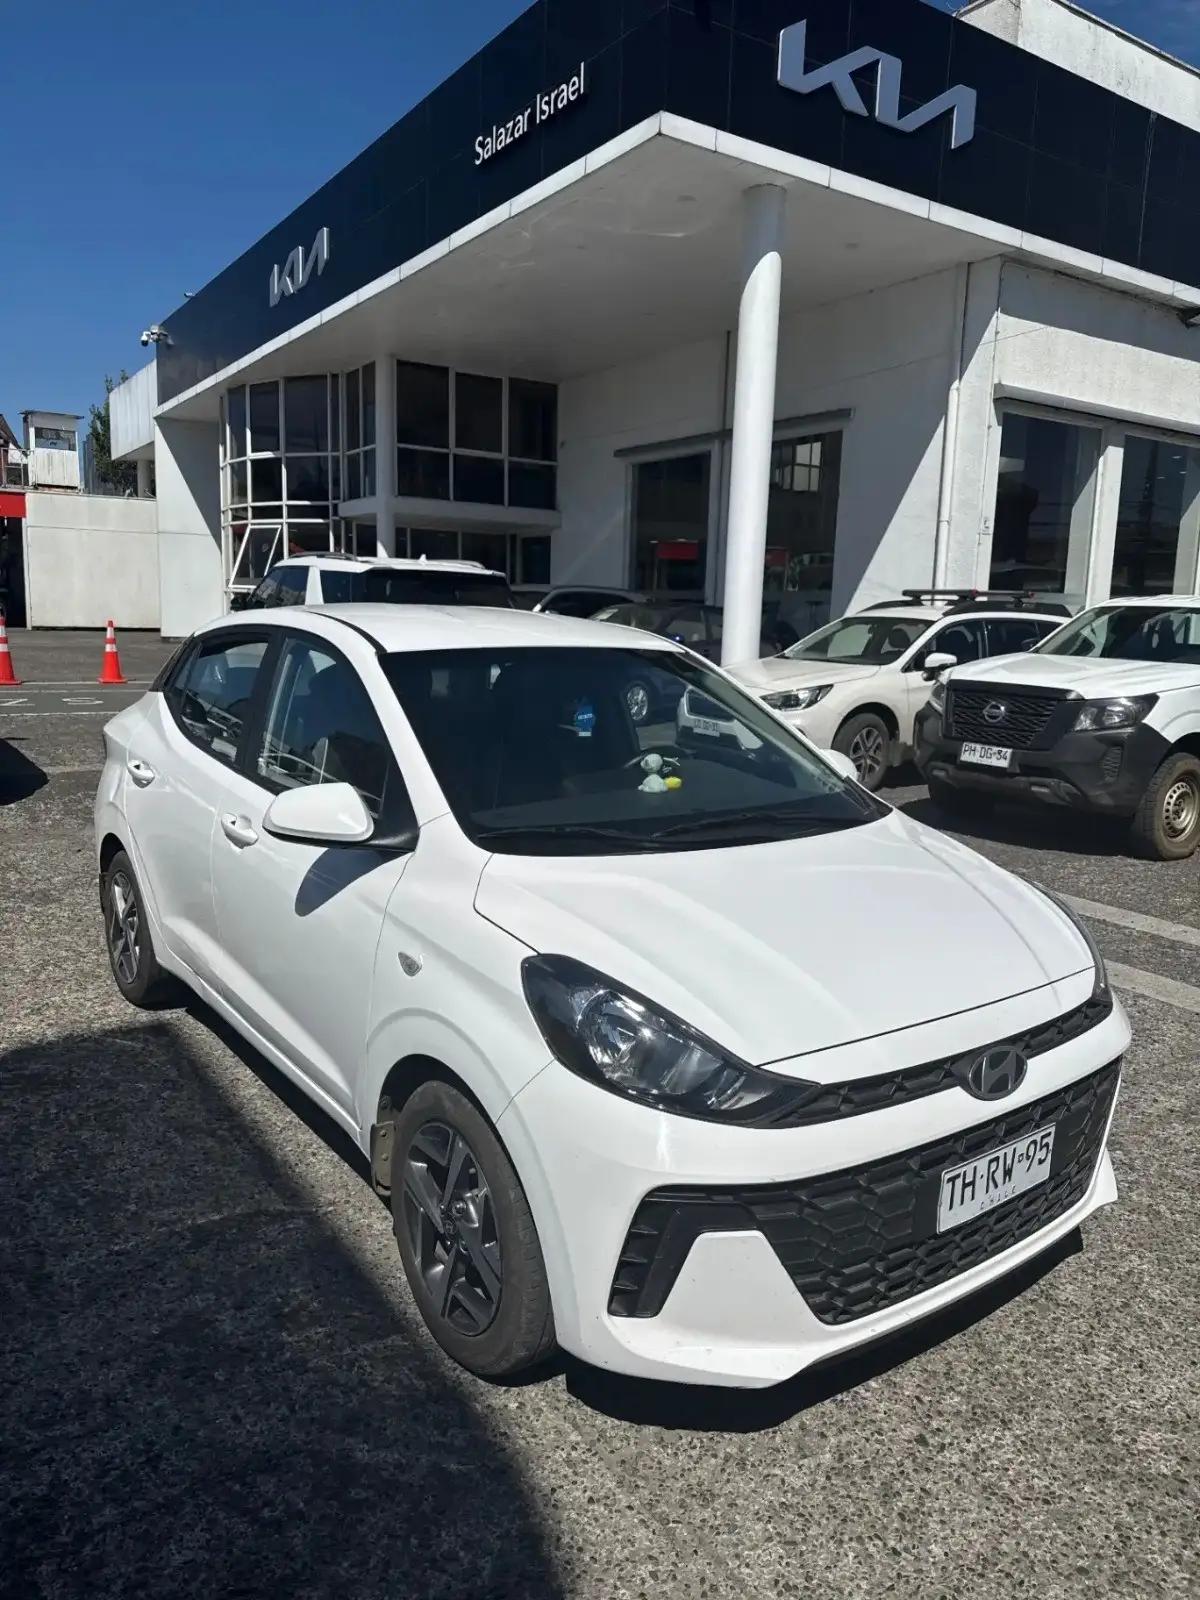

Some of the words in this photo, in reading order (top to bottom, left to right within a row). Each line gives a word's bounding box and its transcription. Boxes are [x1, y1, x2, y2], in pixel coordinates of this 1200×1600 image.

[475, 107, 531, 165] Salazar
[536, 61, 585, 124] Israel
[777, 19, 977, 150] KIA
[269, 226, 330, 308] KIA
